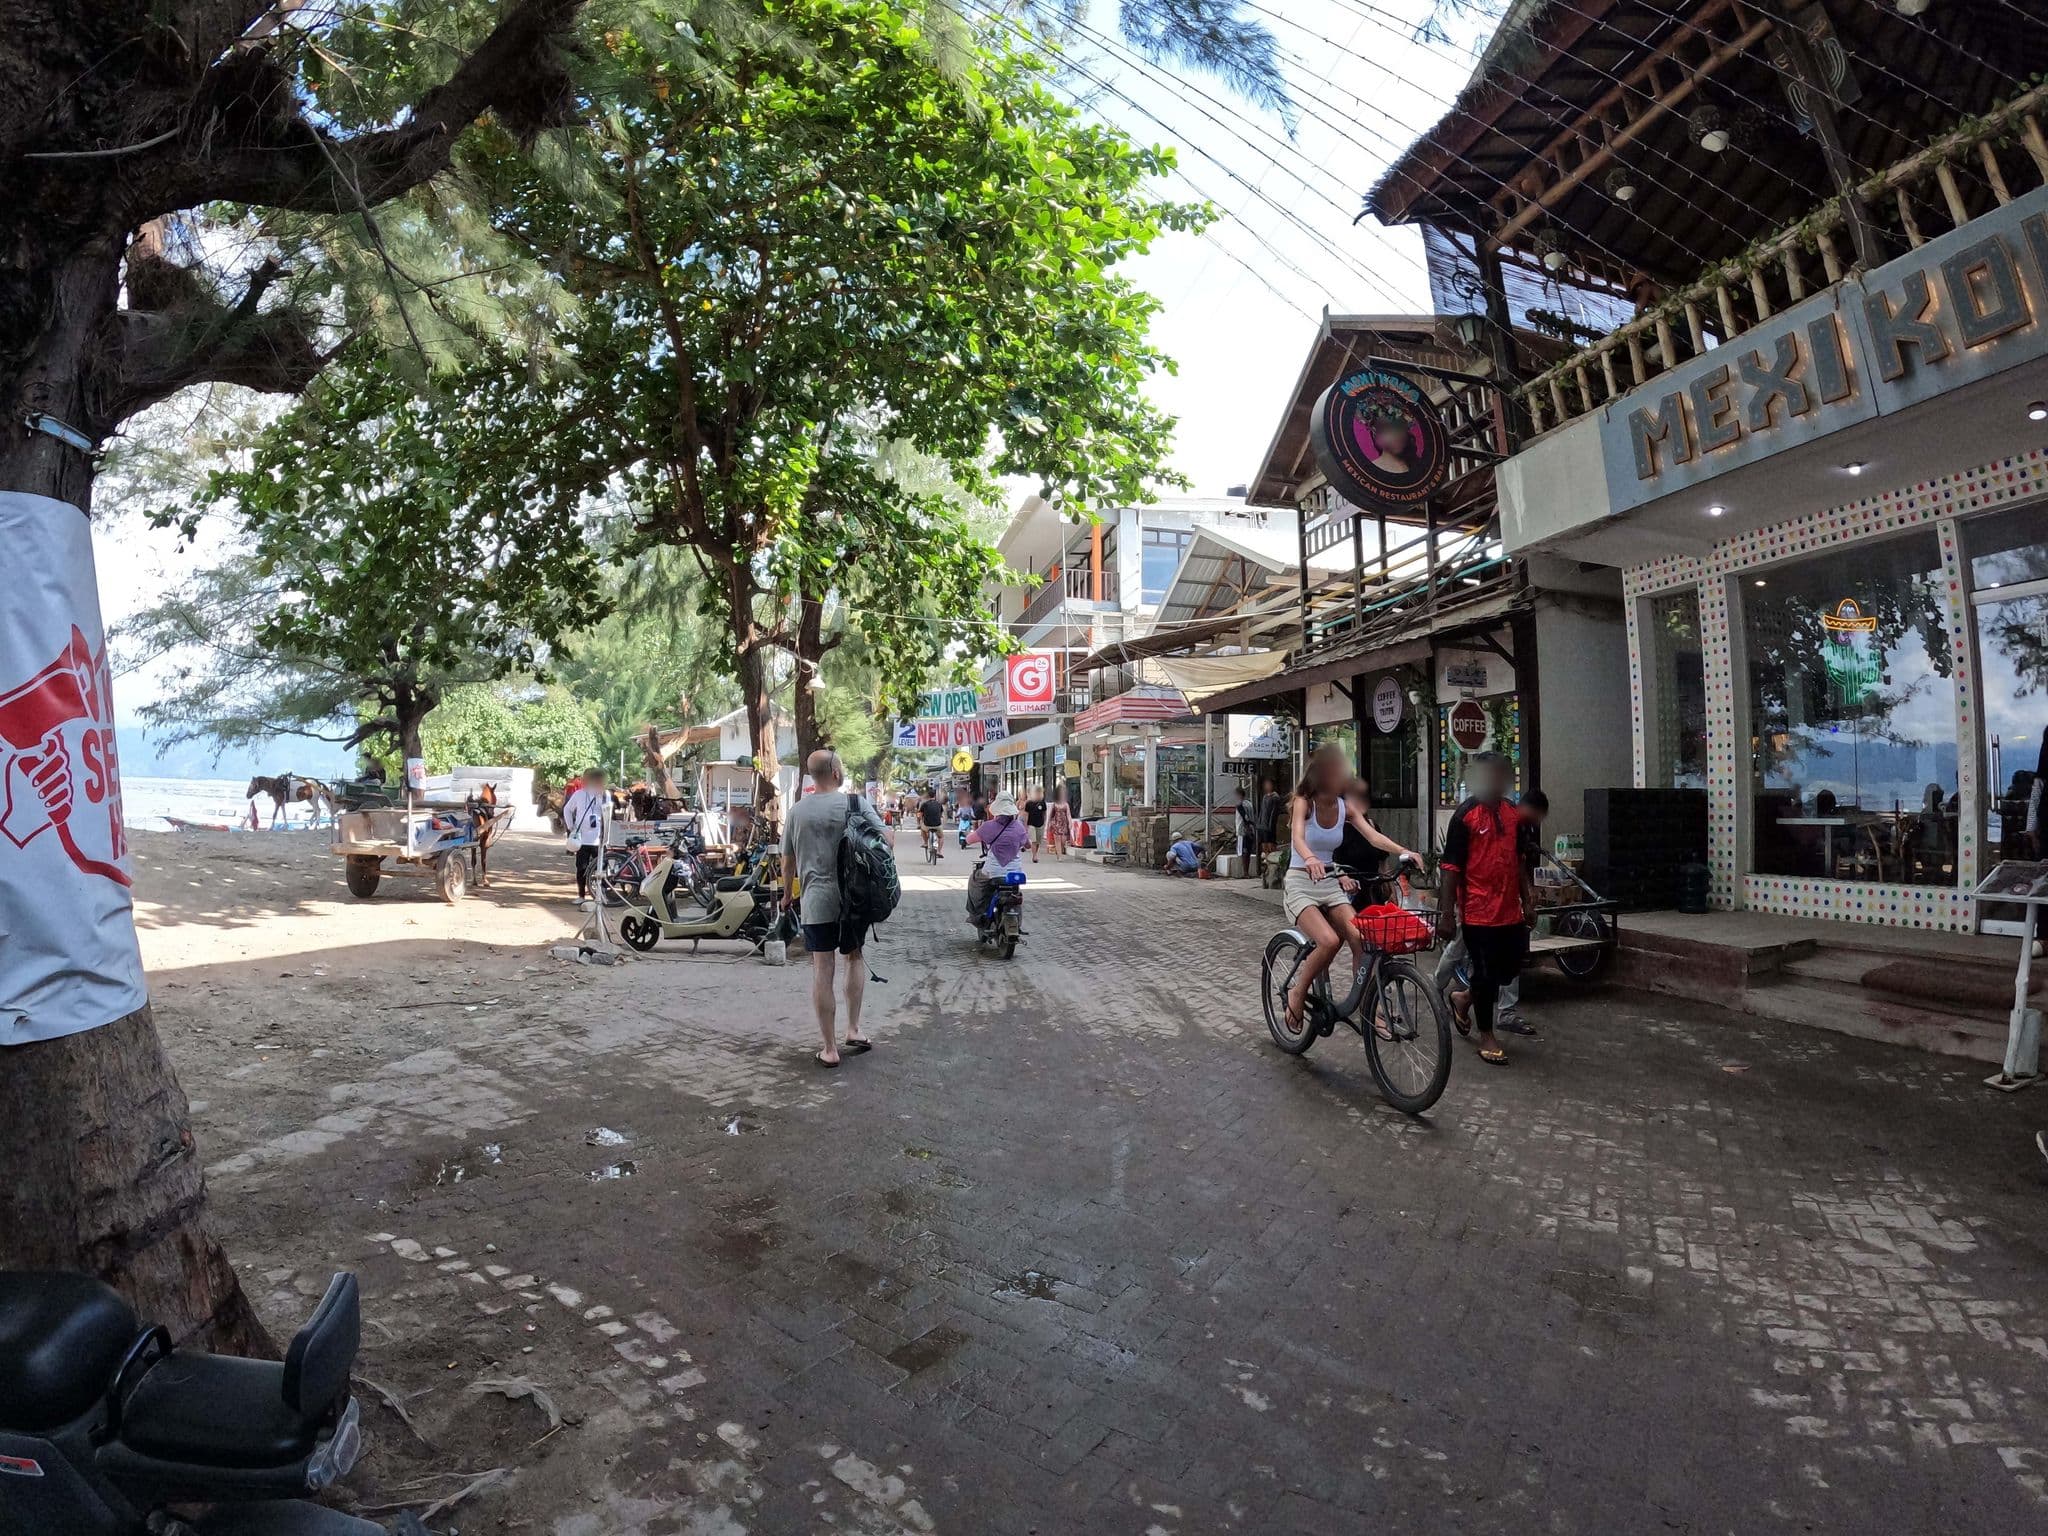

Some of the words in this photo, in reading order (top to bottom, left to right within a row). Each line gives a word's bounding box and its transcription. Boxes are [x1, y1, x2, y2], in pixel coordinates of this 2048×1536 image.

[1342, 459, 1378, 494] MEXICAN
[1379, 486, 1430, 502] RESTAURANT
[945, 690, 977, 715] OPEN
[1009, 703, 1051, 713] GILIMART
[899, 722, 916, 739] 2
[917, 722, 949, 747] NEW
[954, 719, 986, 746] GYM
[984, 716, 1003, 729] NOW
[1453, 718, 1486, 733] COFFEE
[898, 738, 916, 747] LEVELS
[986, 731, 1006, 742] OPEN
[1227, 763, 1255, 774] BIKE
